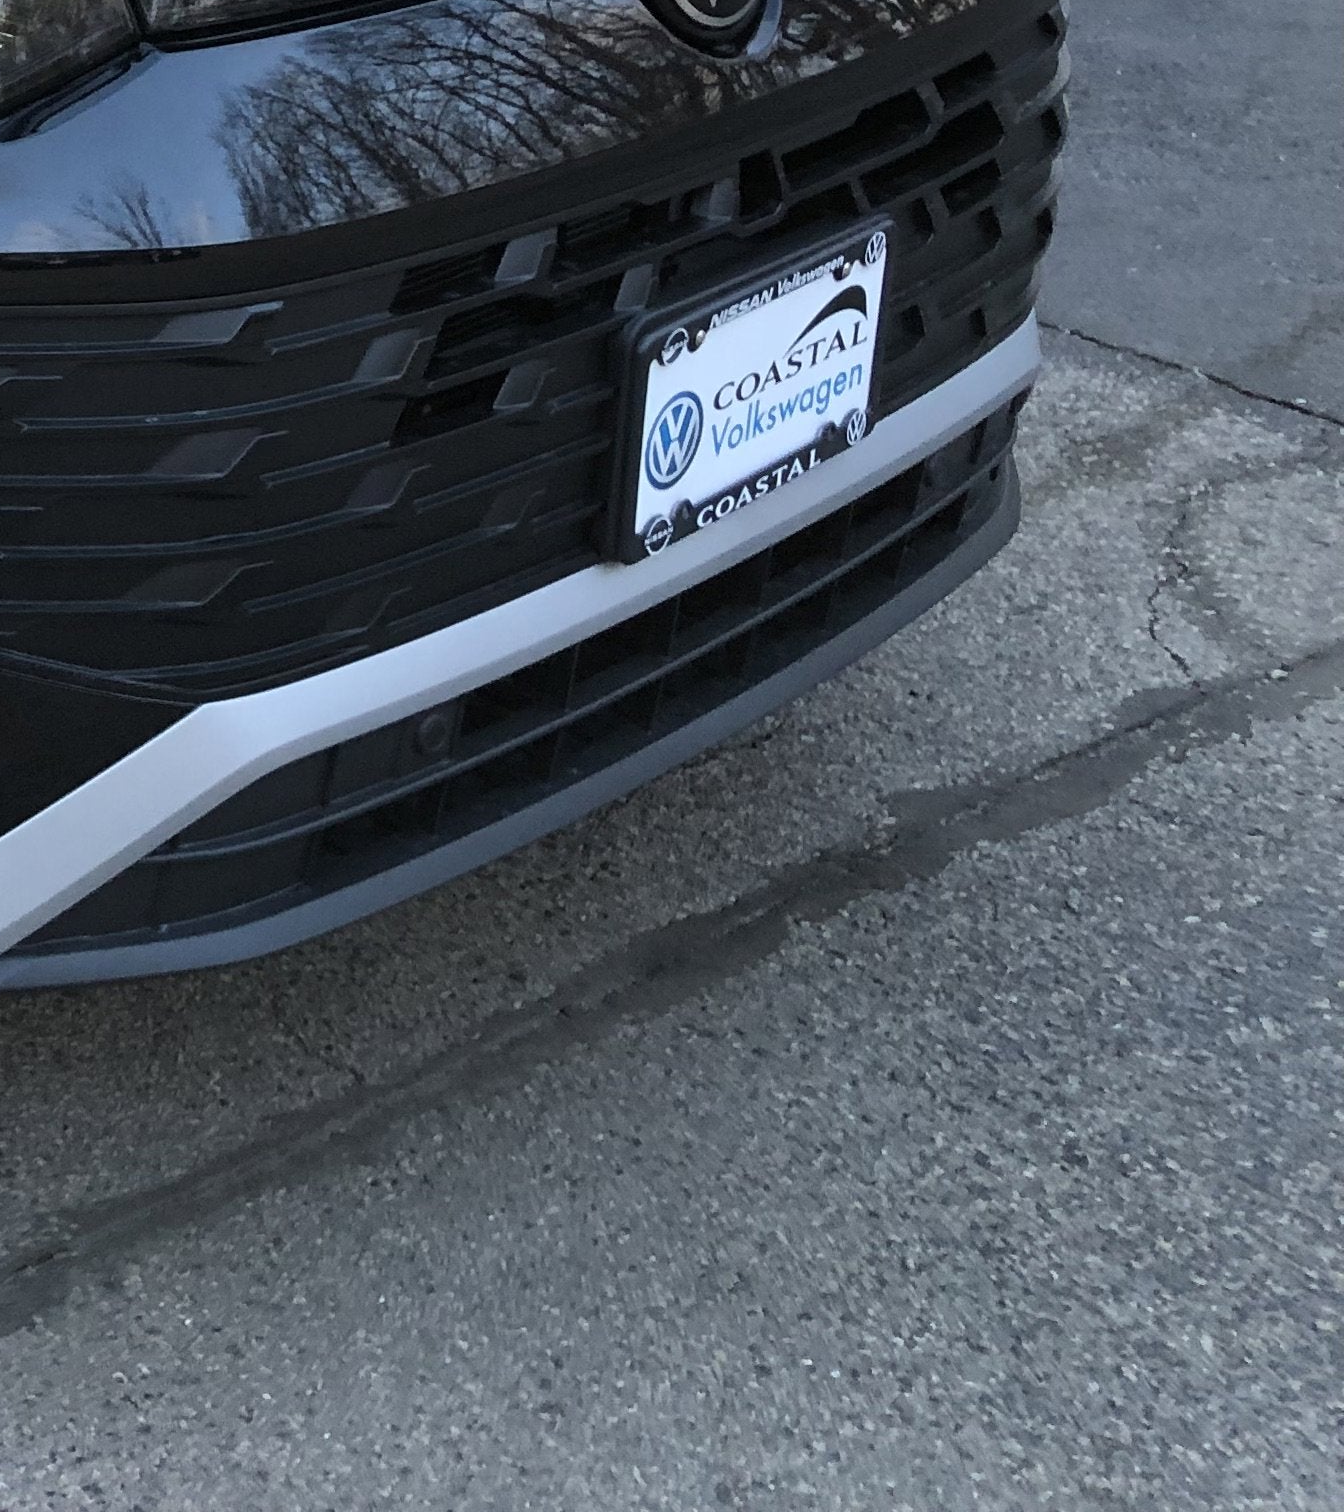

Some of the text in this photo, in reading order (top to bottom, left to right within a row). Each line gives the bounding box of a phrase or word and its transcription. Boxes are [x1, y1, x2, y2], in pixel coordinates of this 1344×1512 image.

[709, 287, 774, 330] NISSAN
[712, 321, 868, 411] COASTAL
[711, 363, 863, 457] Volkswagen
[696, 448, 821, 528] COASTAL
